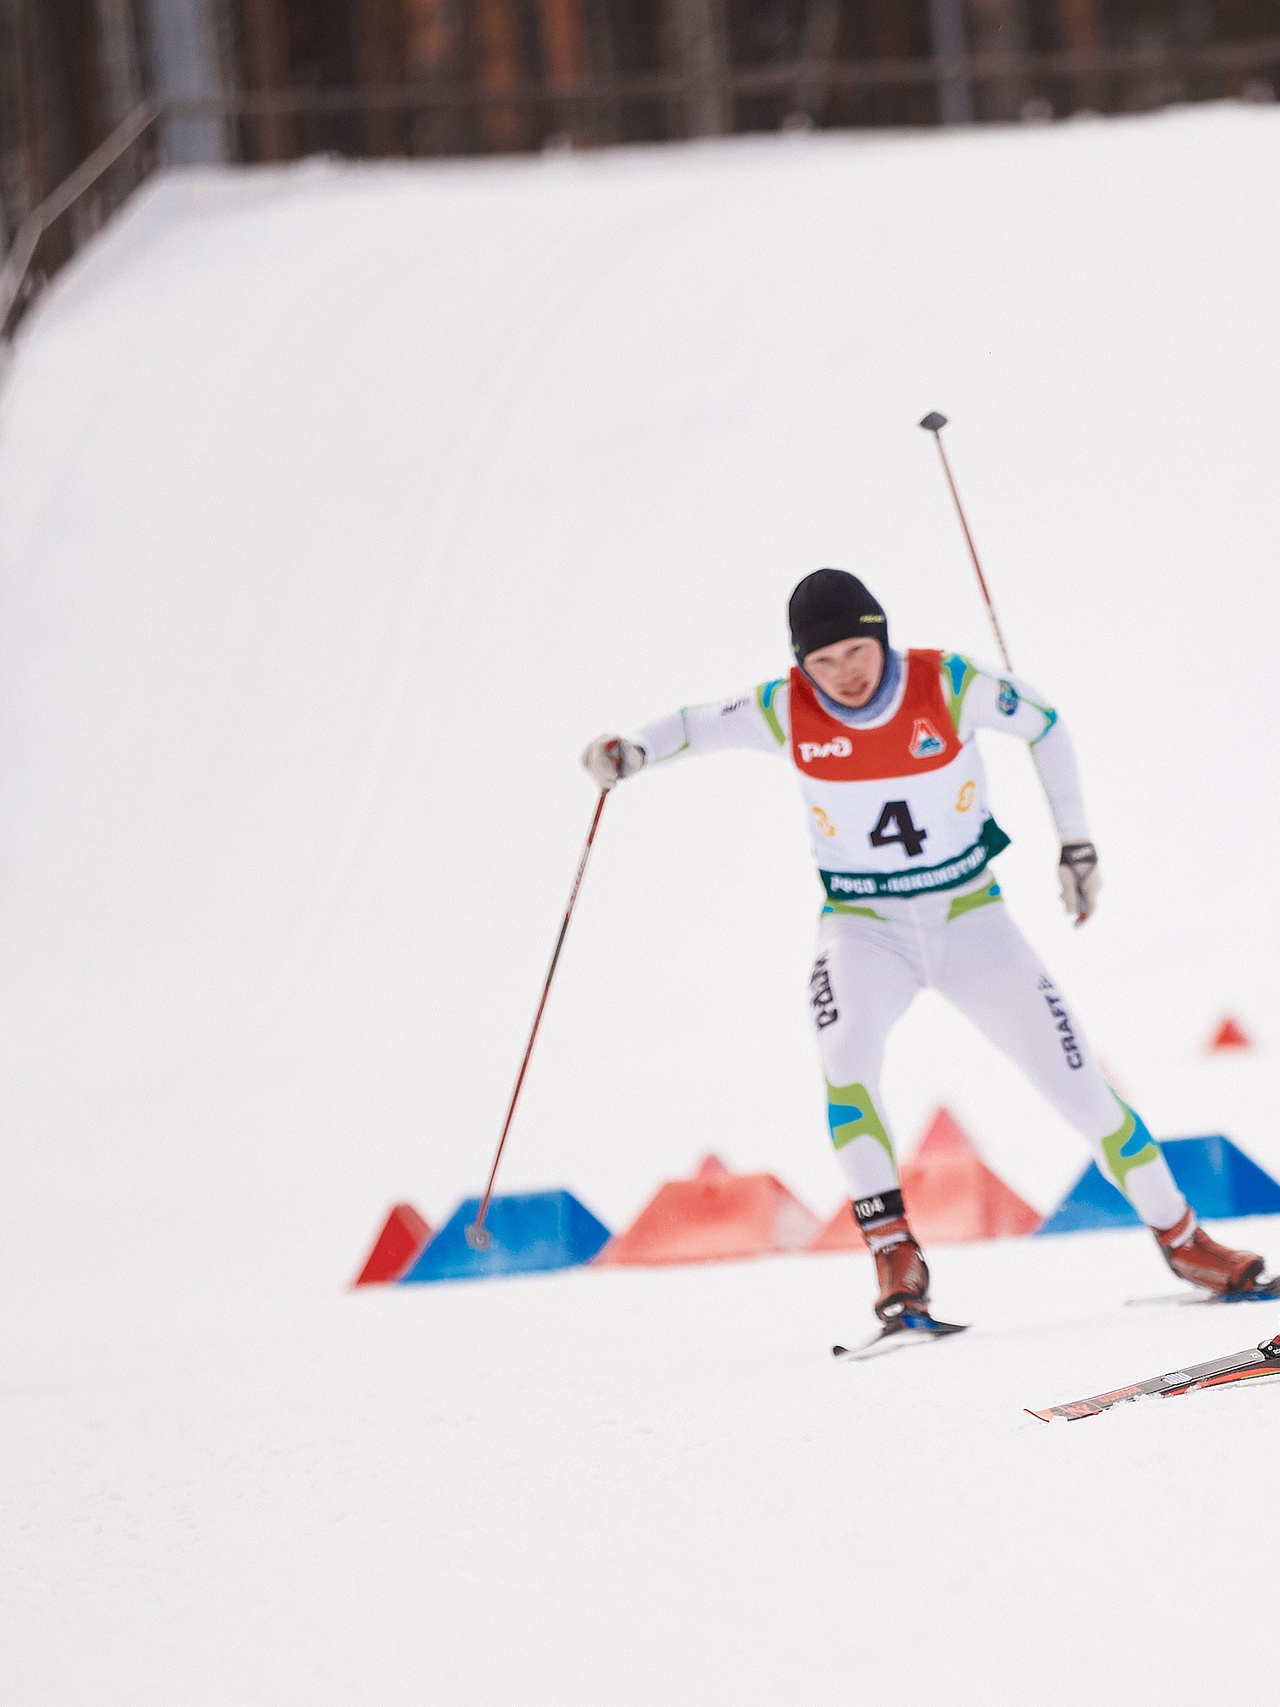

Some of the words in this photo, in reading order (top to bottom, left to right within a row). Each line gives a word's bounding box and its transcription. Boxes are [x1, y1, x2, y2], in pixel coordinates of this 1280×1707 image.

[869, 800, 928, 857] 4
[1044, 995, 1083, 1070] CRAFT
[854, 1196, 886, 1219] 104
